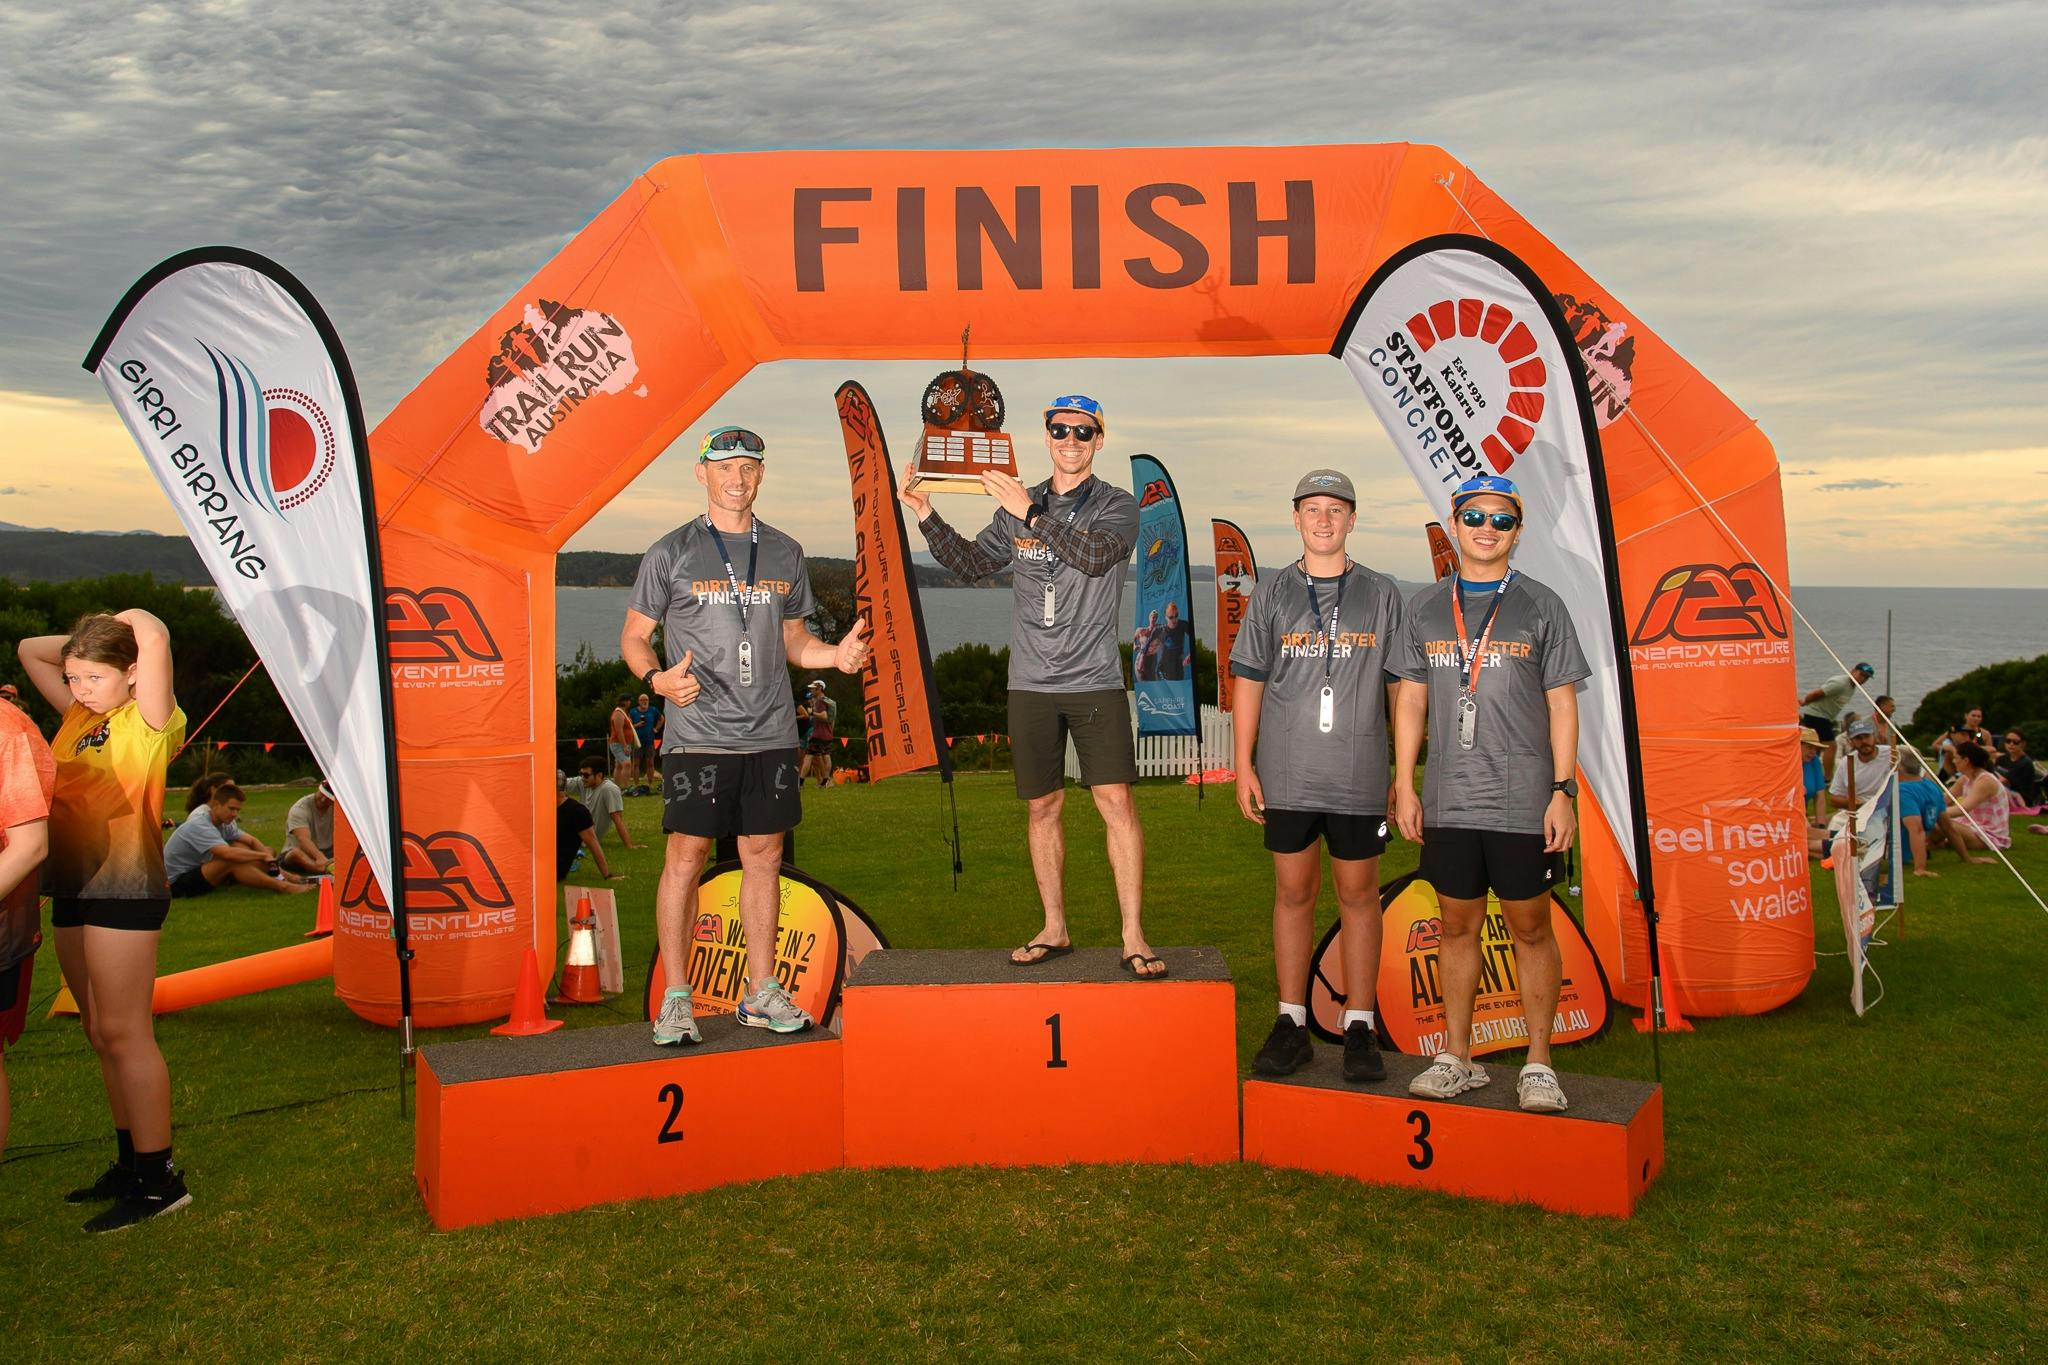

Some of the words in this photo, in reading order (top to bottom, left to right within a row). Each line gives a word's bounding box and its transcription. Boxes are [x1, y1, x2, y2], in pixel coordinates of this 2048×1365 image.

[793, 180, 1316, 292] FINISH
[485, 373, 565, 443] TRAIL
[552, 312, 624, 381] RUN
[1440, 365, 1476, 420] Kalaru
[1452, 356, 1468, 382] Est.
[1467, 381, 1487, 409] 1930
[1583, 361, 1631, 420] UN
[525, 350, 627, 448] AUSTRALIA
[1369, 347, 1461, 484] CONCRET
[120, 359, 182, 441] GIRRI
[170, 443, 267, 580] BIRRANG
[850, 448, 866, 485] IN
[691, 579, 730, 597] DIRT
[872, 488, 889, 585] ADVENTURE
[882, 589, 897, 642] EVENT
[890, 649, 914, 756] SPECIALISTS
[1315, 631, 1377, 648] MSTER
[1424, 639, 1457, 657] DIRT
[1652, 659, 1716, 670] ADVENTURE
[1719, 658, 1749, 667] EVENT
[390, 663, 505, 680] VENTURE
[403, 681, 437, 689] EVENT
[440, 679, 504, 688] SPECIALISTS
[1723, 817, 1791, 850] new
[1727, 844, 1804, 887] south
[339, 907, 517, 931] IN2ADENTURE
[1730, 884, 1808, 922] wales
[351, 928, 390, 939] ADVENTU
[448, 925, 515, 938] SPECIALISTS
[783, 929, 803, 959] IN
[801, 933, 816, 962] 2
[1486, 913, 1511, 941] AR
[1416, 1014, 1435, 1025] THE
[1045, 1013, 1067, 1069] 1
[657, 1083, 685, 1145] 2
[1406, 1110, 1434, 1171] 3
